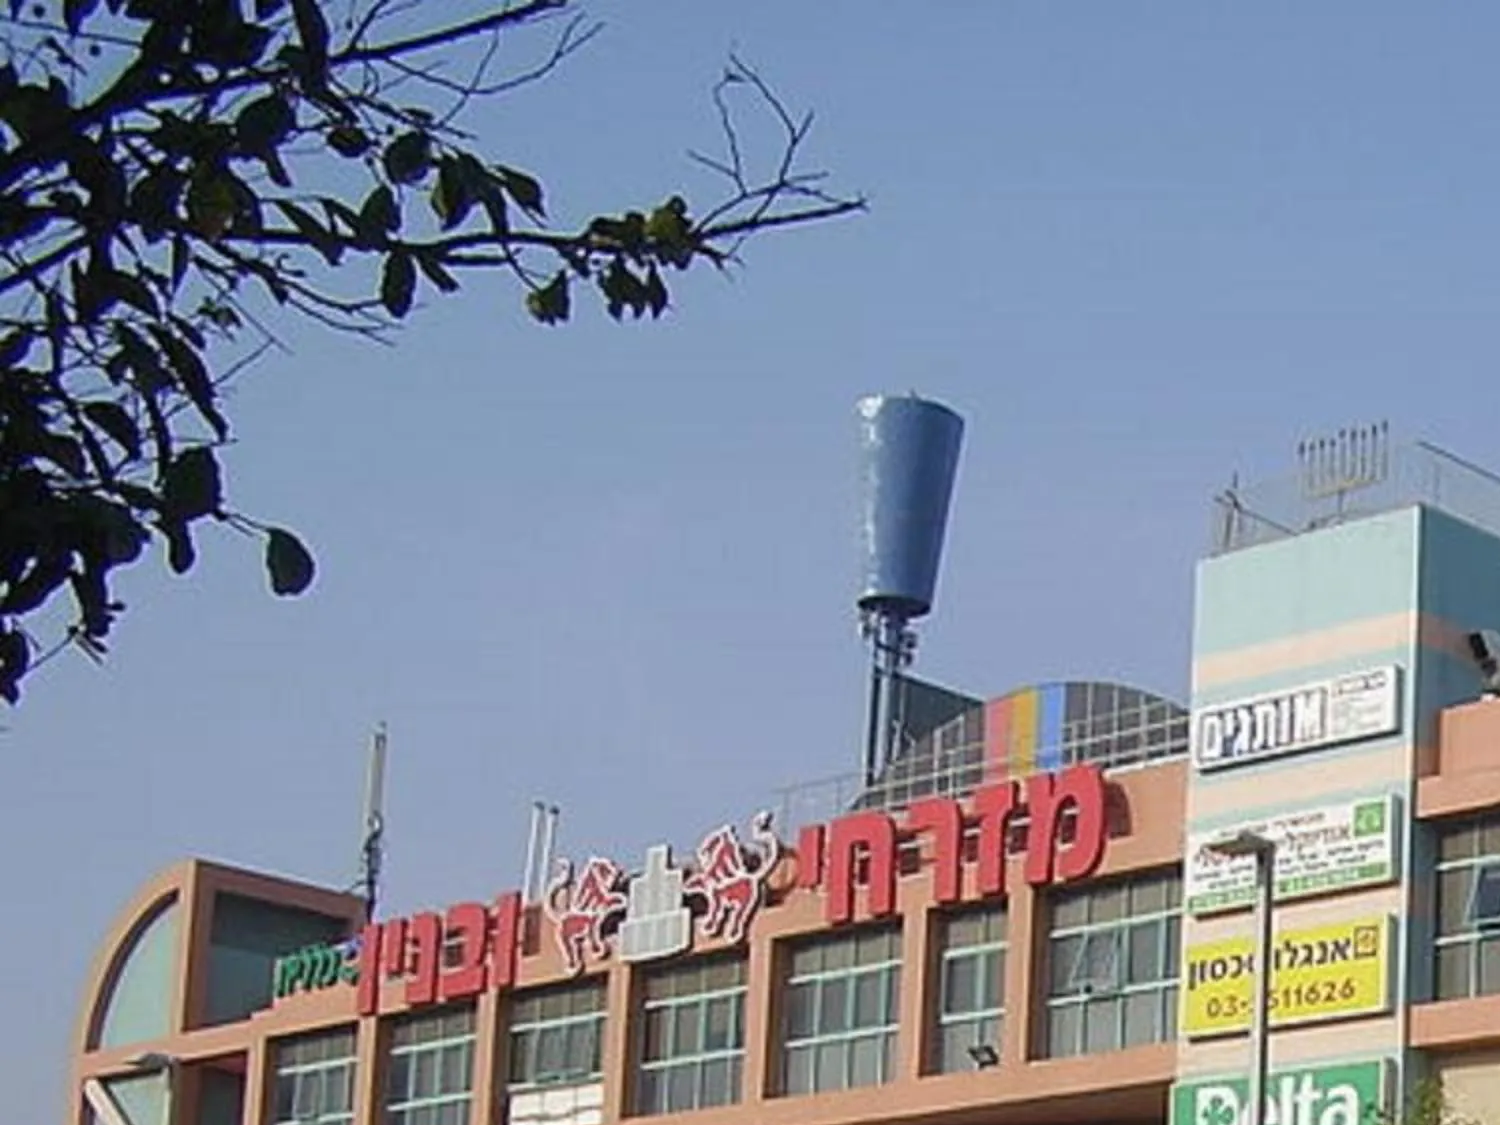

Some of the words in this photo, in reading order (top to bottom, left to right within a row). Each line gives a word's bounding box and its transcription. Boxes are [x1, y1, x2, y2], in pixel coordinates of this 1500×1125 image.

[1201, 686, 1326, 758] מותגים
[799, 762, 1107, 922] מזרחי
[360, 892, 518, 1015] ובניו
[1273, 938, 1352, 972] אנגלו
